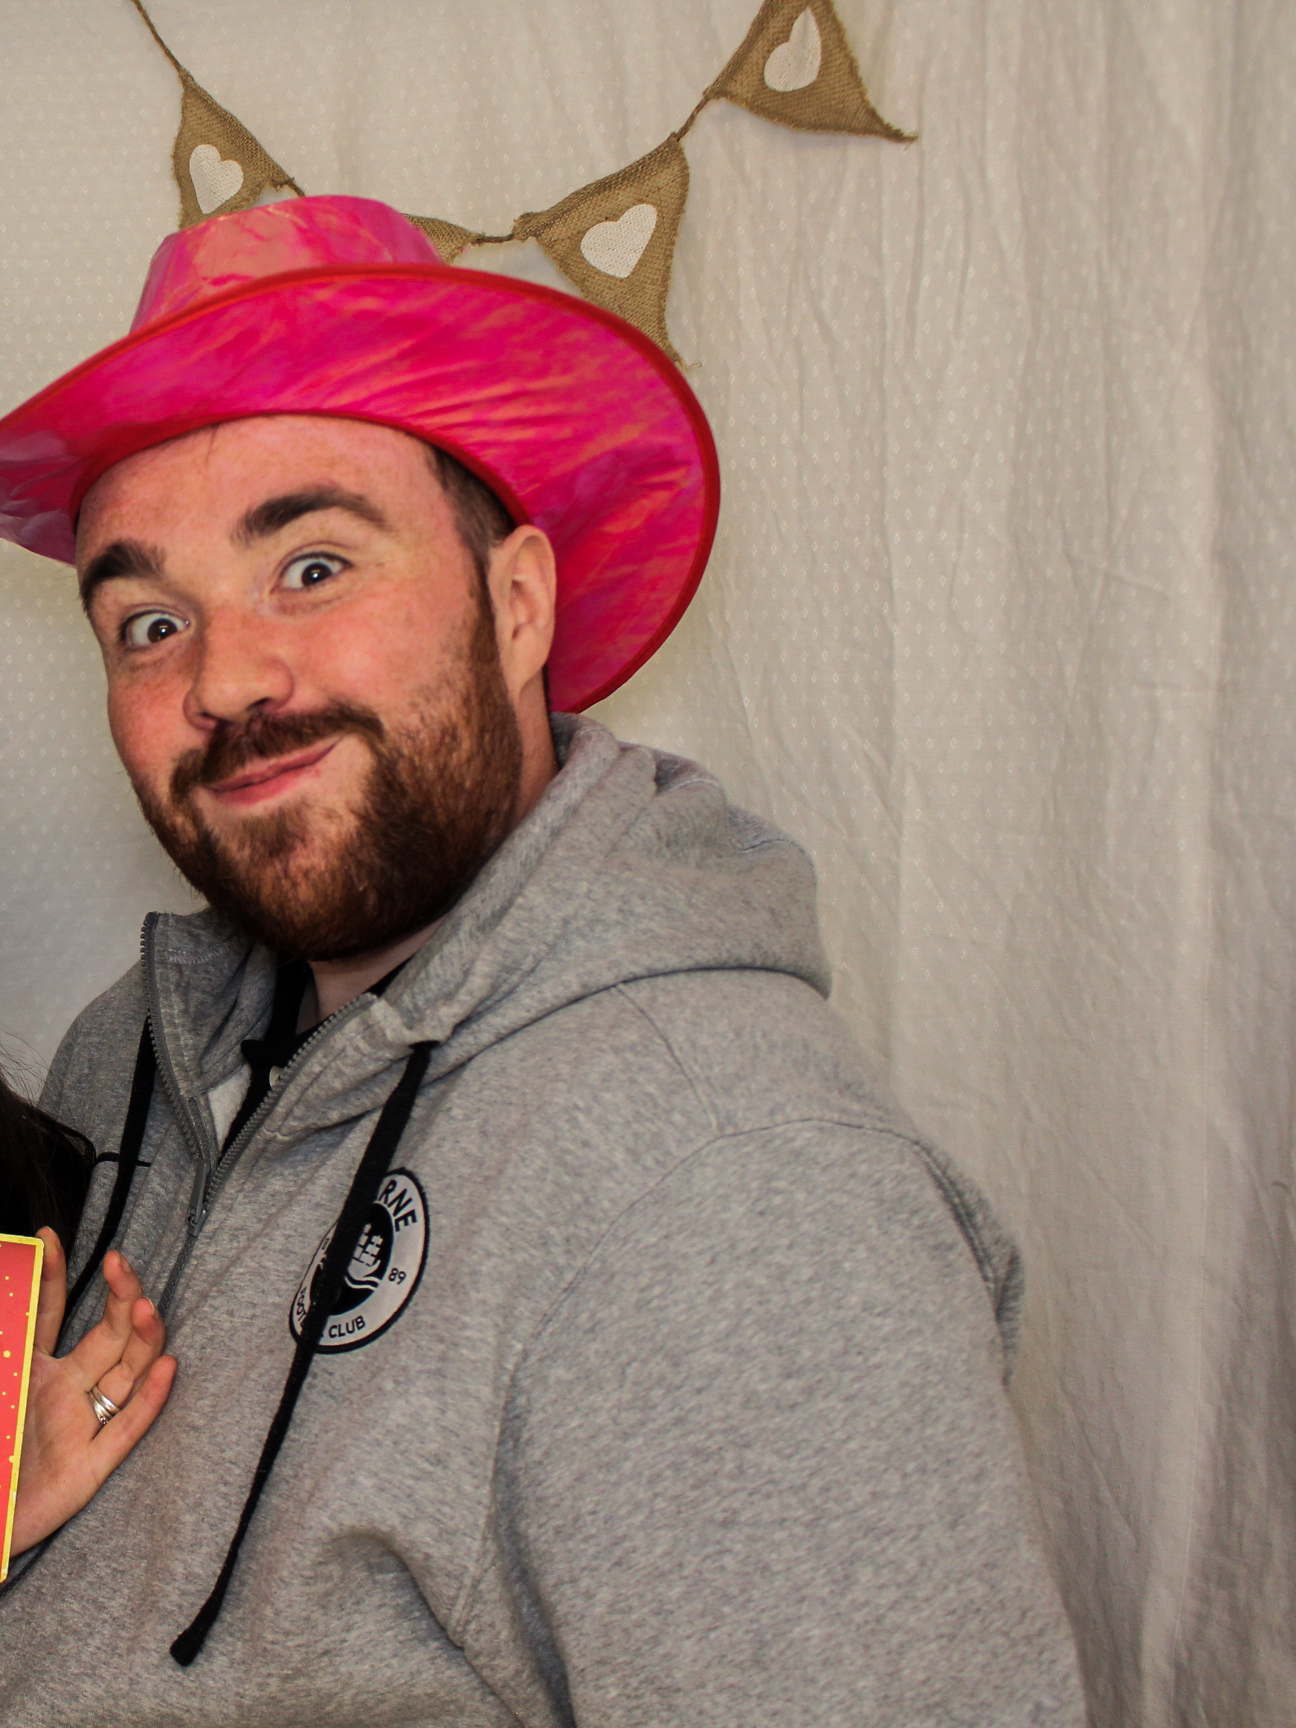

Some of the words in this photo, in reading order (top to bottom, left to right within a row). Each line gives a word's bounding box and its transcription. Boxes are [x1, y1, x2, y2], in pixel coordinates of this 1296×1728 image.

[377, 1178, 418, 1233] RNE
[388, 1267, 407, 1286] 89
[328, 1315, 367, 1339] CLUB
